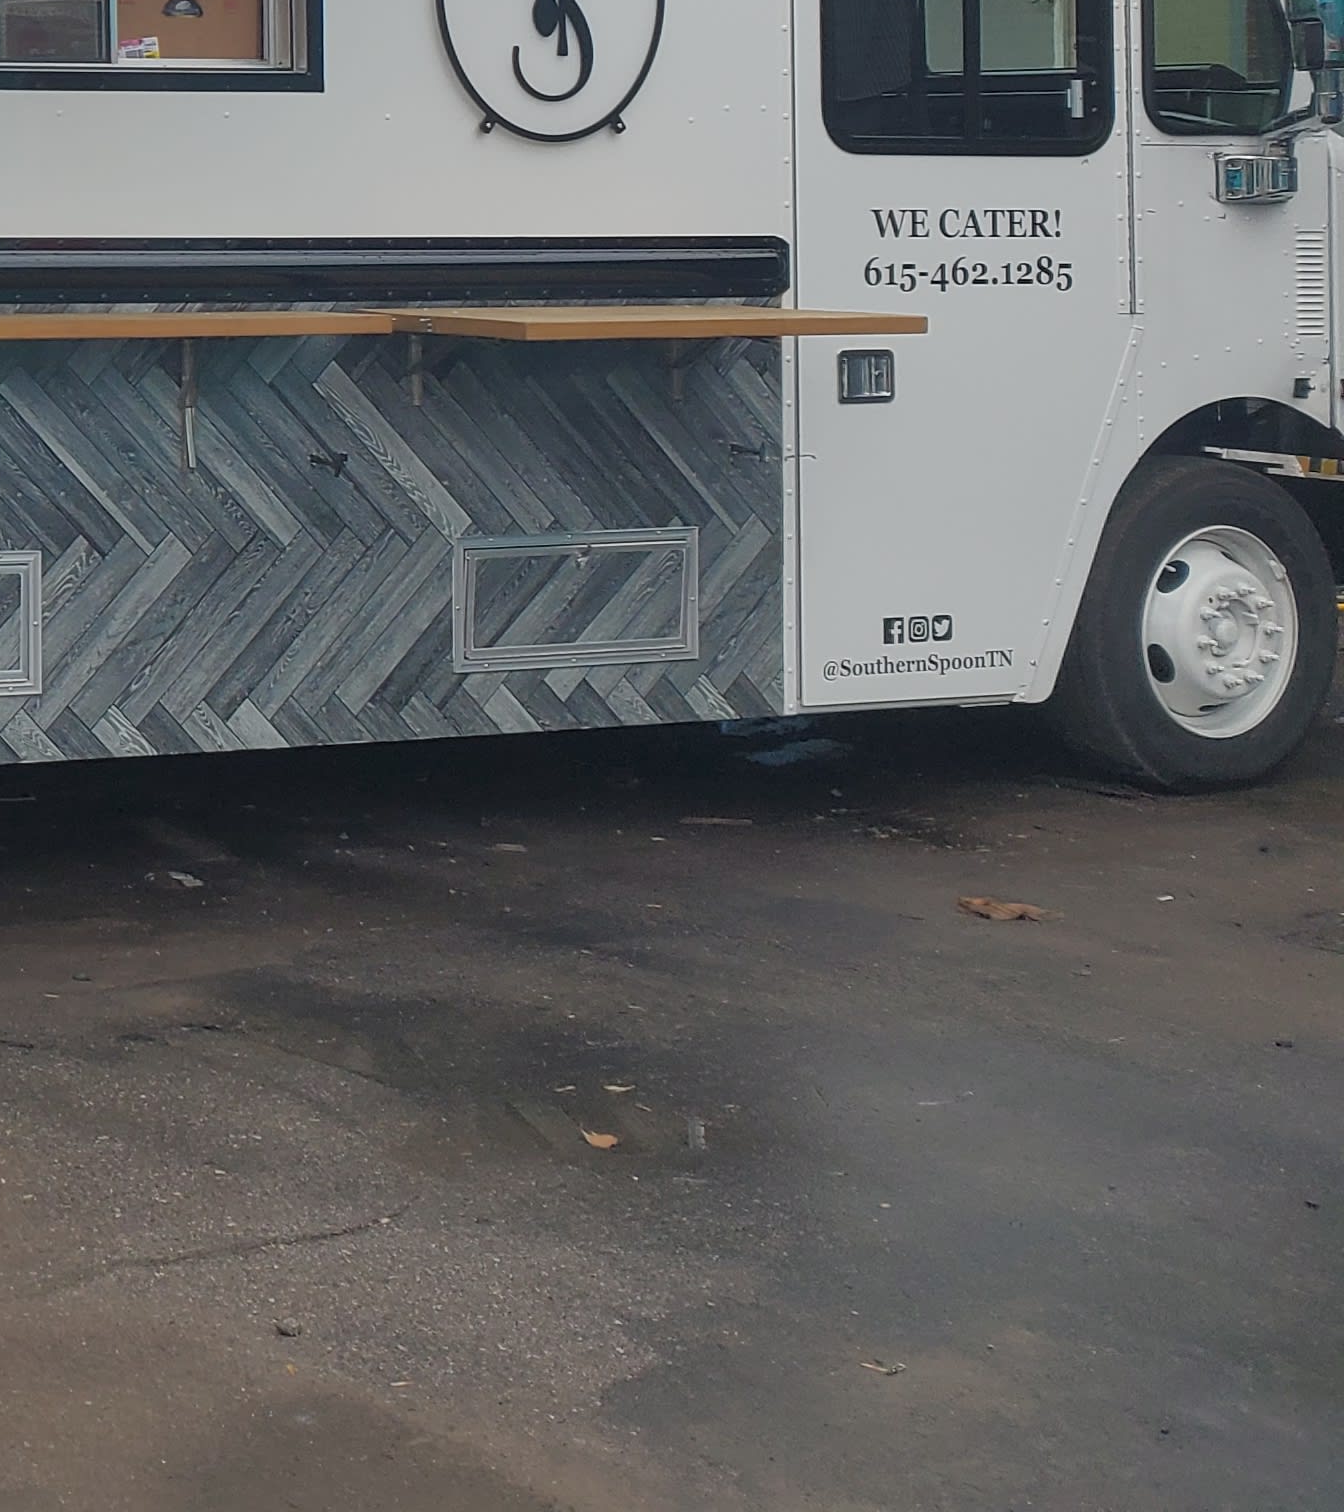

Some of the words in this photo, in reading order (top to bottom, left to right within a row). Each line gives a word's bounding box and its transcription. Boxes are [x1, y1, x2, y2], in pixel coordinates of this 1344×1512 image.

[869, 208, 930, 238] WE
[938, 208, 1062, 238] CATER!
[863, 255, 1074, 292] 615-462.1285
[823, 649, 1014, 681] @SouthernSpoonTN
